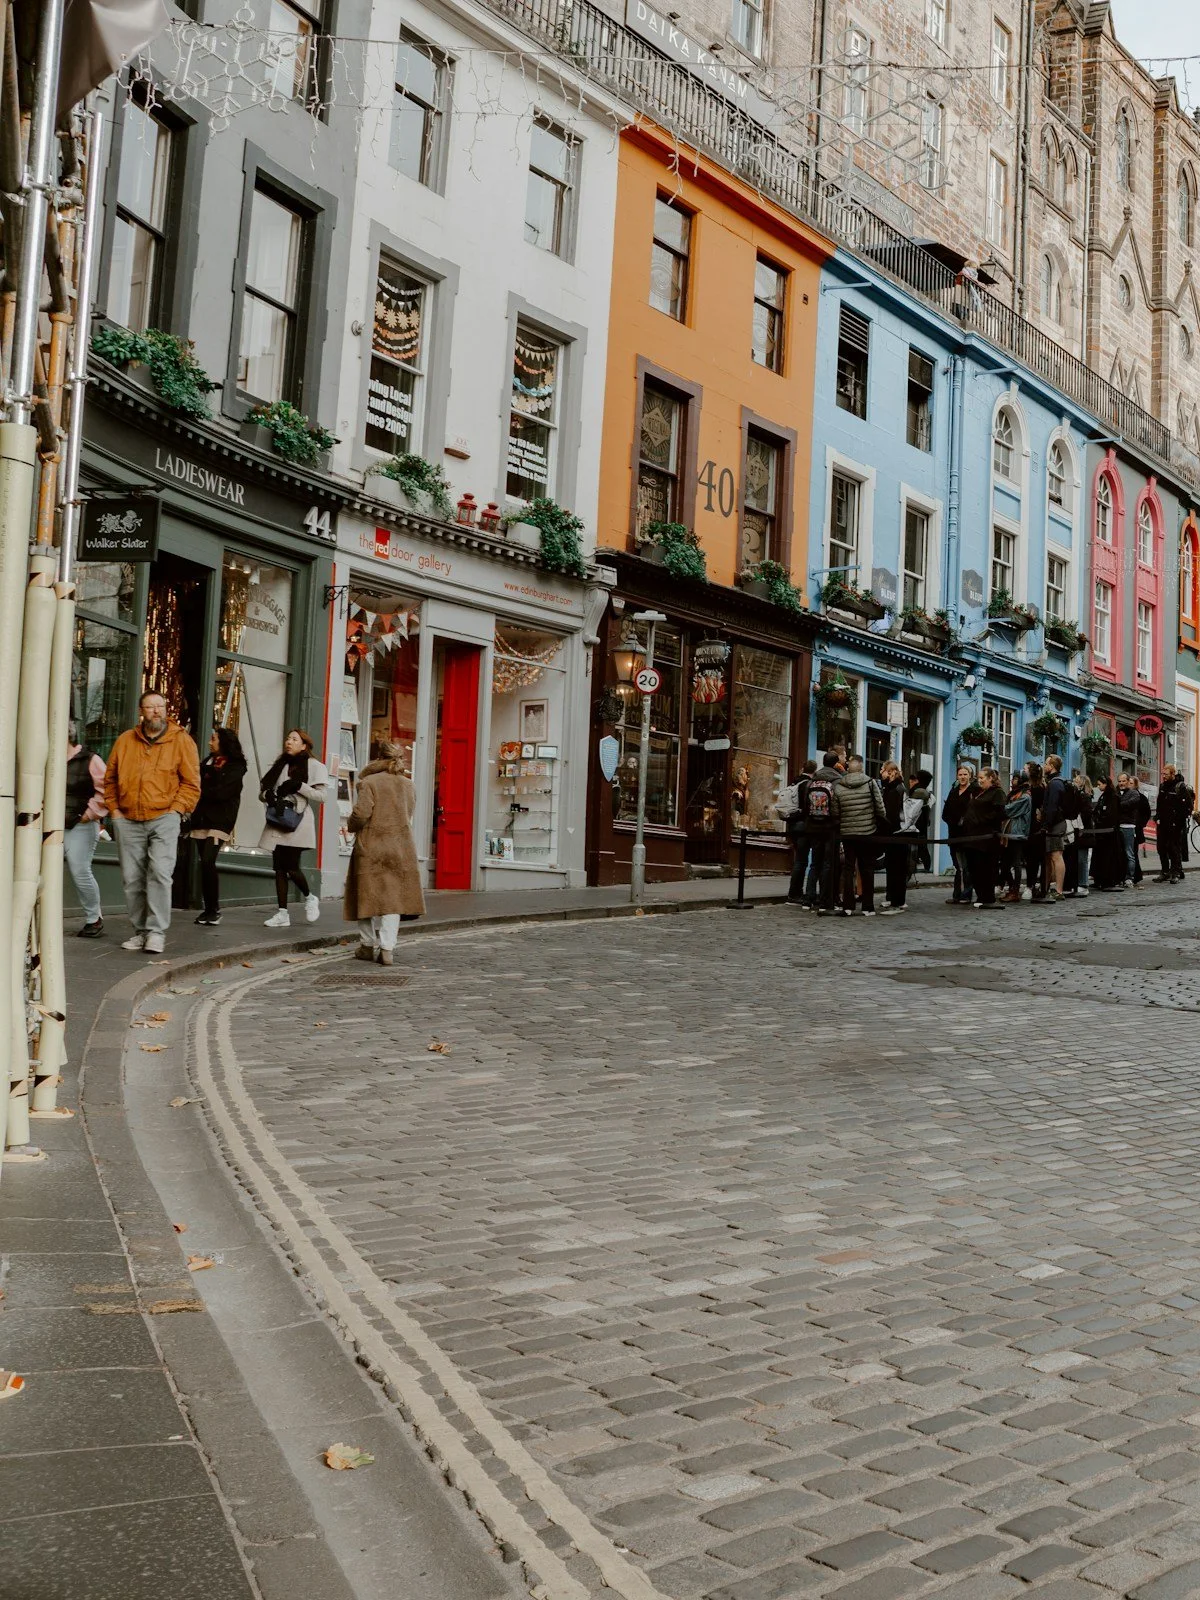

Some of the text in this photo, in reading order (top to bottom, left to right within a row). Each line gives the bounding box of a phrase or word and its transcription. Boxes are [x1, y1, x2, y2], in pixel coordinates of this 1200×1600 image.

[636, 1, 690, 58] DAIKA
[370, 396, 387, 413] and
[390, 385, 411, 407] Local
[385, 417, 407, 438] 2003
[156, 447, 245, 506] LADIESWEAR
[698, 460, 735, 518] 40
[86, 537, 149, 549] Walker Slater
[359, 533, 452, 576] the red door gallery
[503, 581, 573, 606] www.edinburghart.com
[639, 674, 657, 688] 20
